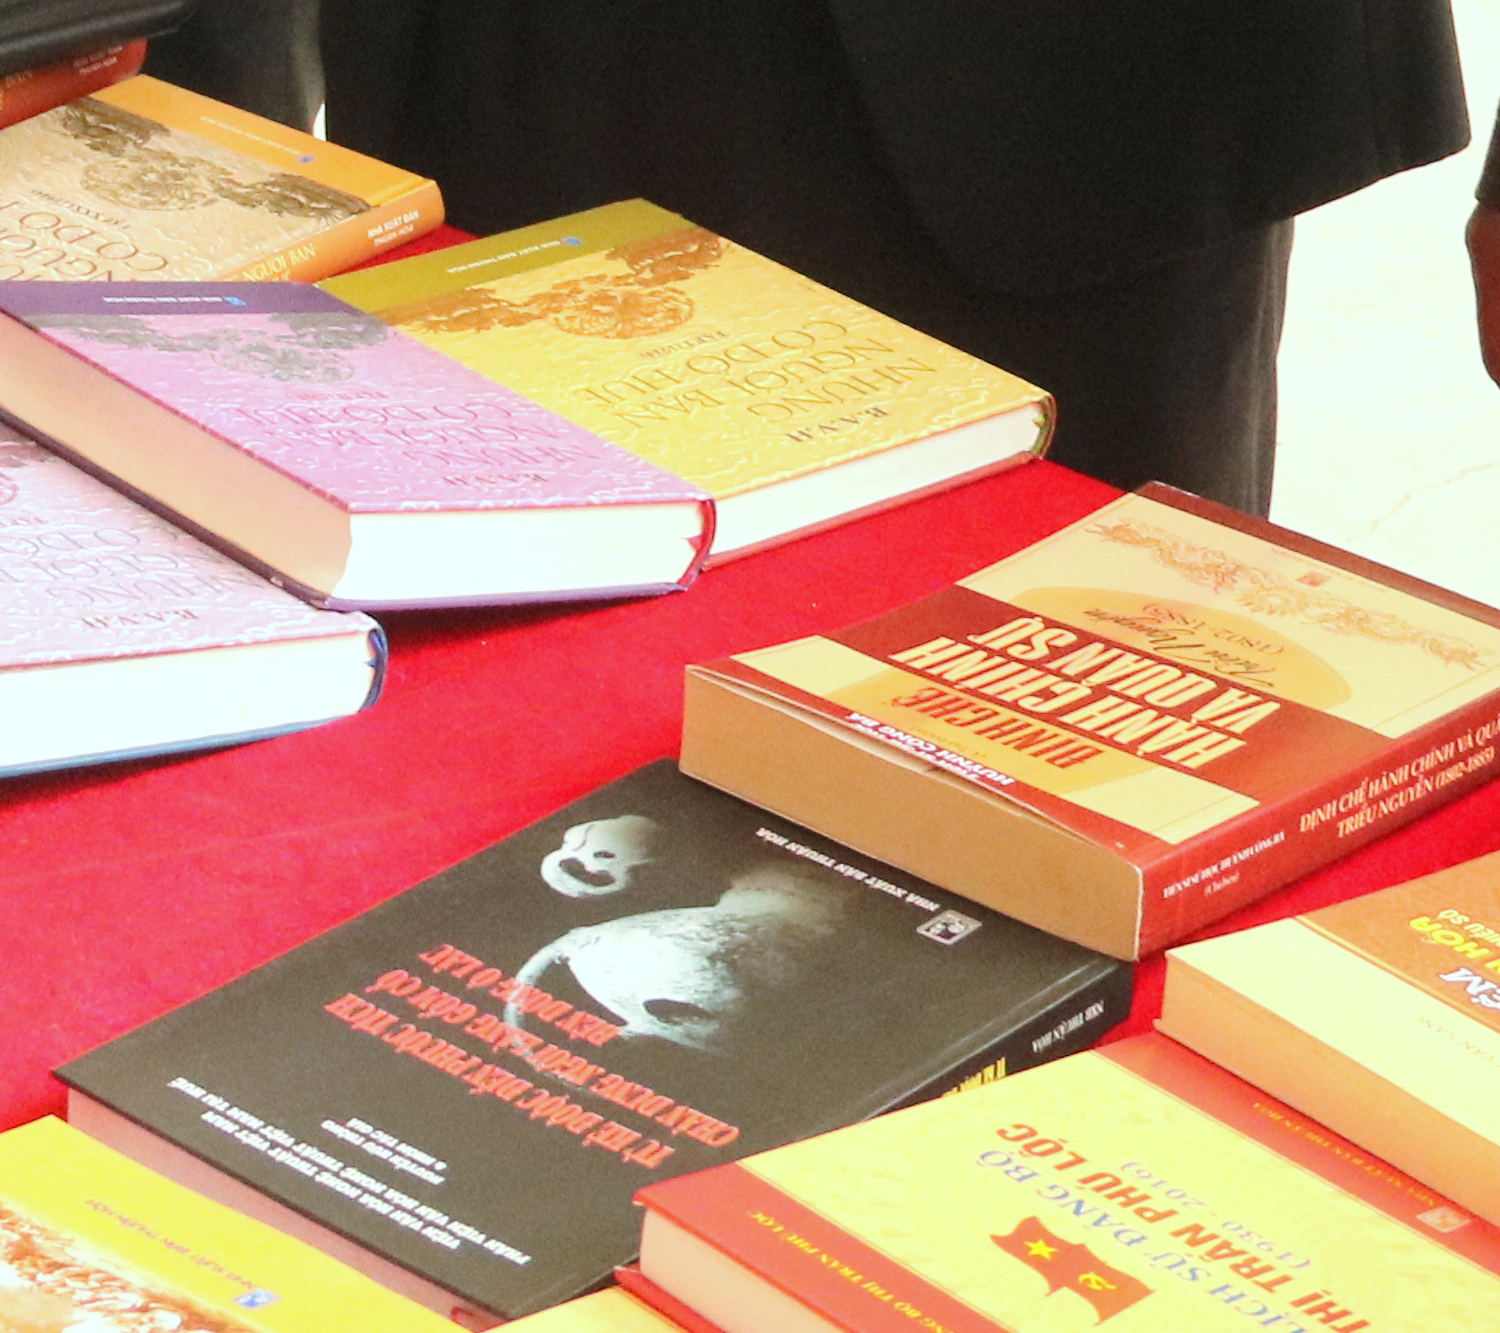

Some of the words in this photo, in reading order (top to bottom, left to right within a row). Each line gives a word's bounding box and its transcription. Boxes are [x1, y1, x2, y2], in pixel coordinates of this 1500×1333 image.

[890, 637, 1092, 713] CHÍNH
[1044, 642, 1216, 709] QUÂN
[1056, 695, 1246, 769] HÀNH
[1190, 687, 1280, 734] VÀ
[1407, 915, 1489, 964] HÓA
[590, 1074, 675, 1118] DUNG
[989, 1121, 1087, 1182] LỘC
[1072, 1168, 1178, 1228] PHÚ
[1115, 1159, 1207, 1214] 2016)
[1167, 1220, 1296, 1295] TRẤN
[1221, 1218, 1314, 1273] (1930
